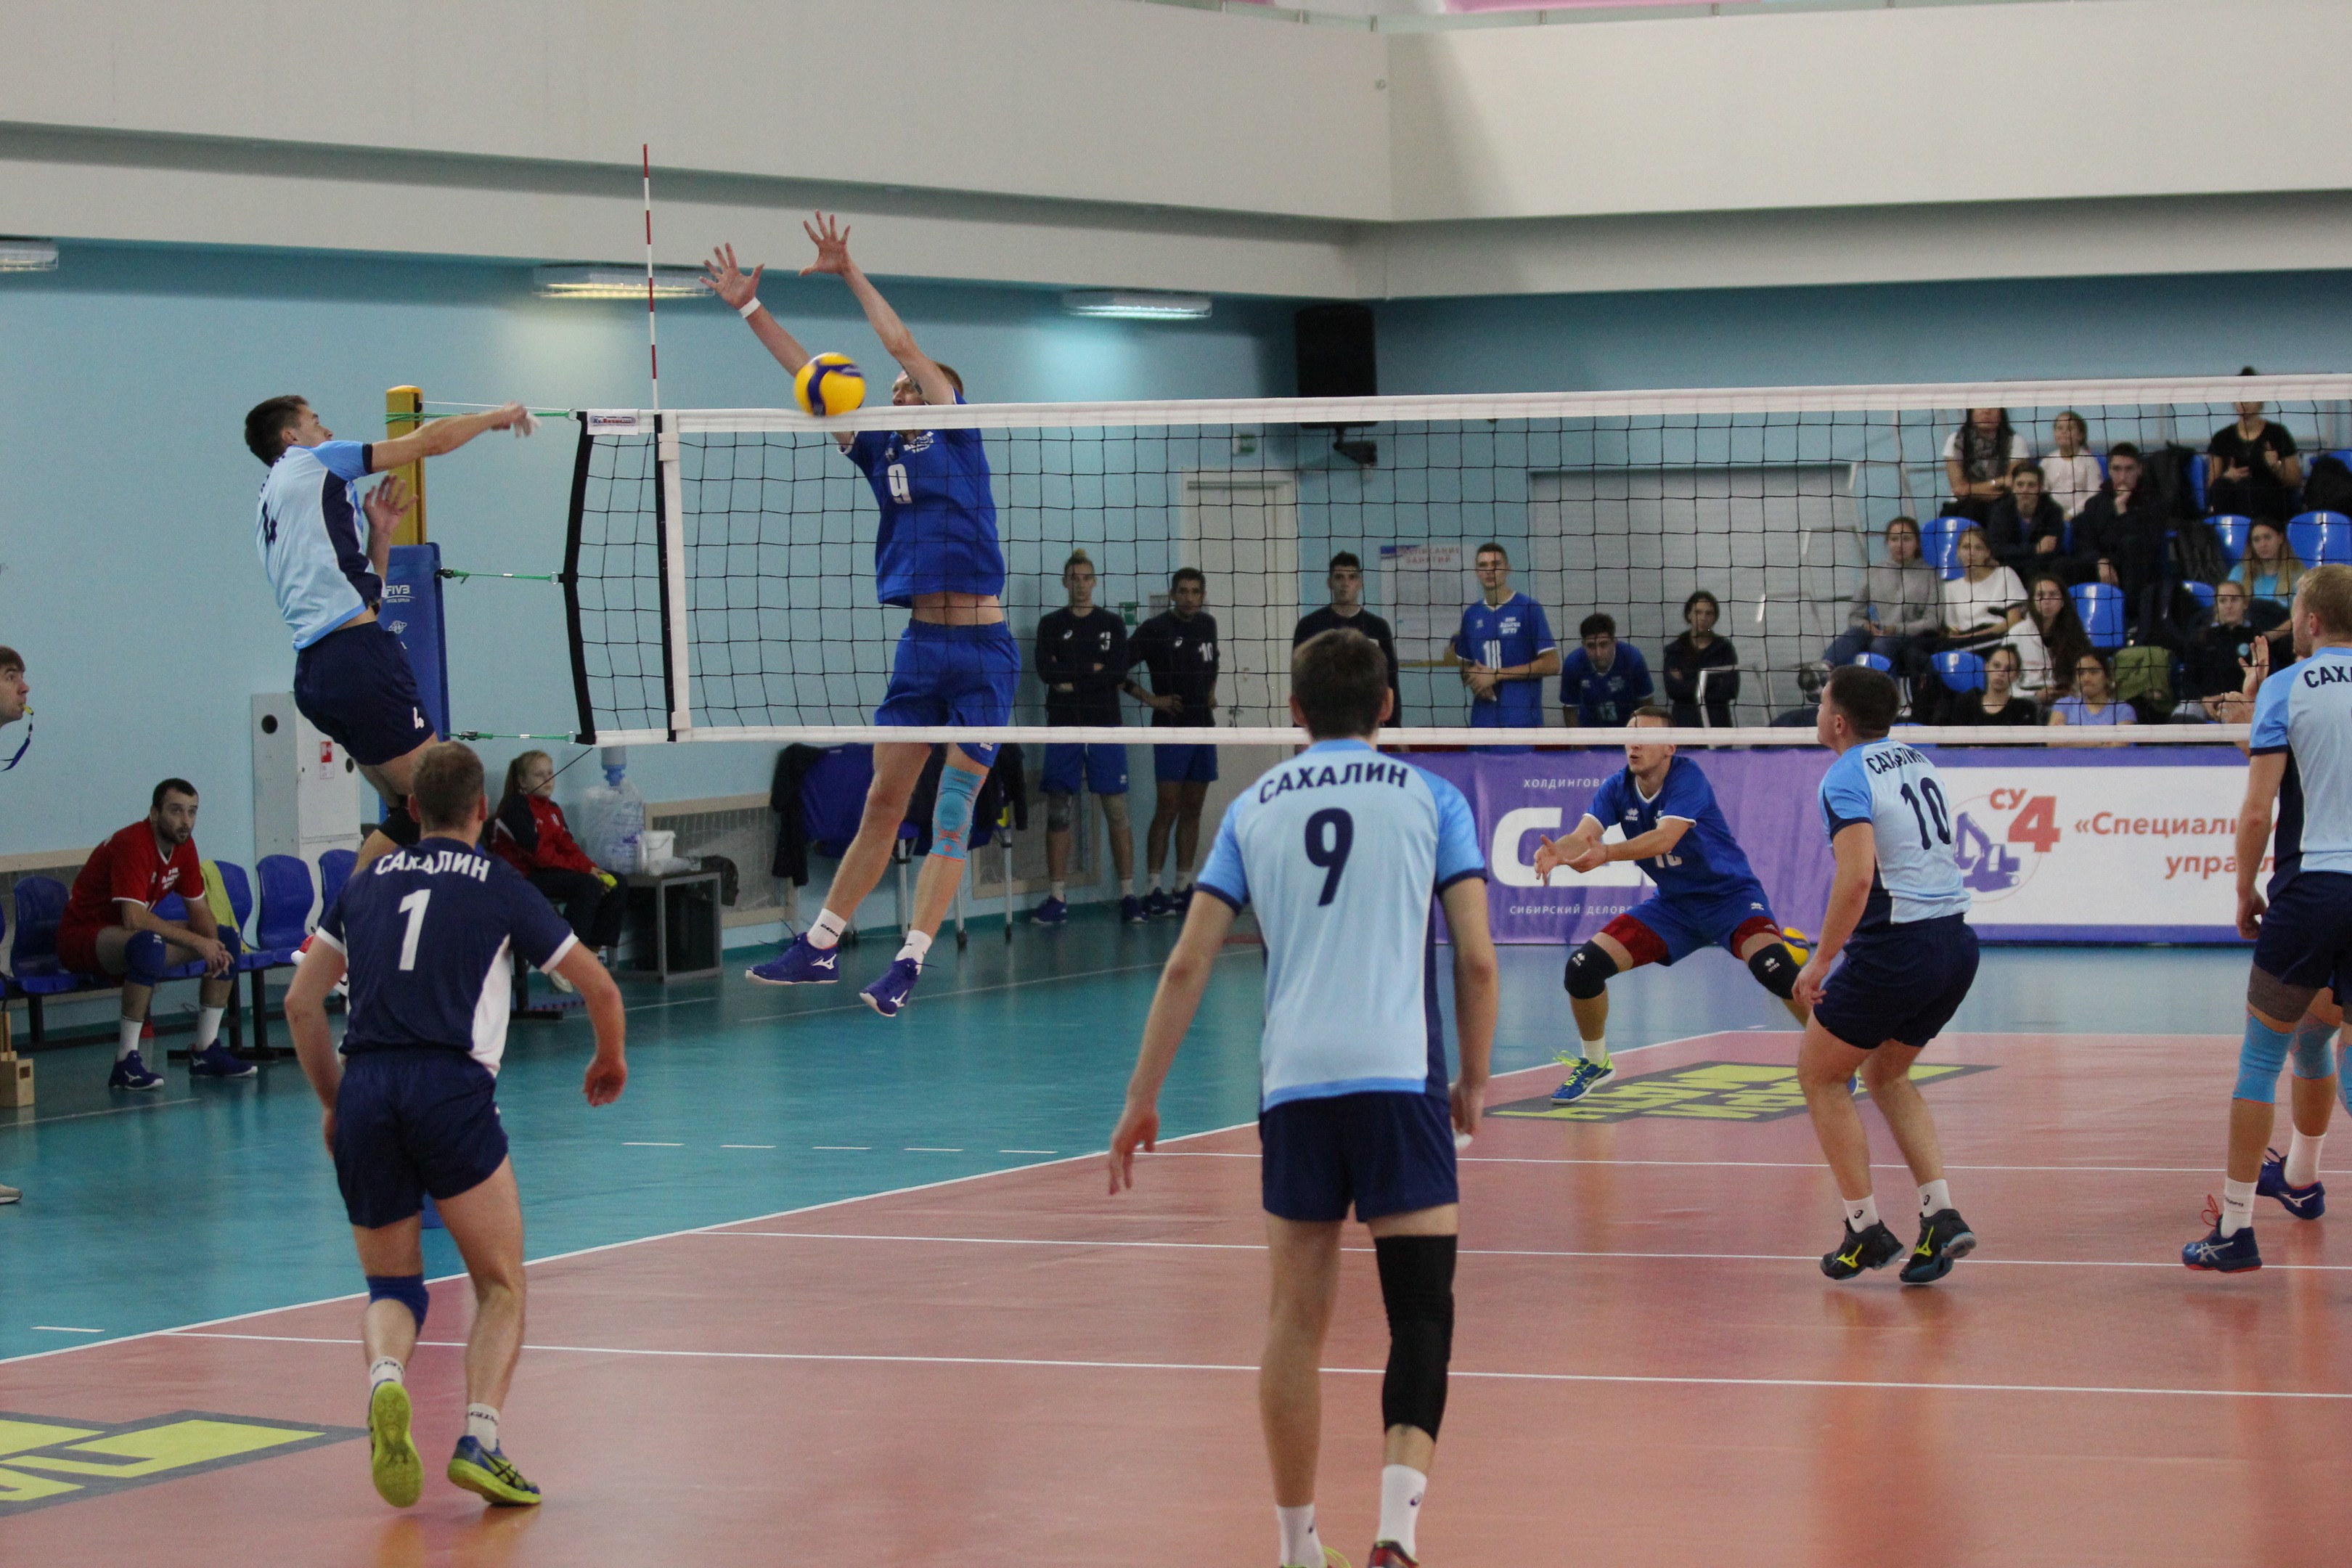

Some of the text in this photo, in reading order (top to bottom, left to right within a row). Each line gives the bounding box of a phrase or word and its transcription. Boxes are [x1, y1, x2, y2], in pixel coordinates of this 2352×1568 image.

[888, 463, 912, 505] 9
[2303, 665, 2352, 689] САХ
[413, 706, 425, 730] 4
[1259, 762, 1408, 804] САХАЛИН
[1900, 777, 1951, 850] 10
[2007, 796, 2061, 852] 4
[2075, 812, 2277, 838] «Специал
[1304, 807, 1354, 907] 9
[399, 889, 431, 971] 1
[1510, 904, 1581, 915] СИБИРСКИЙ
